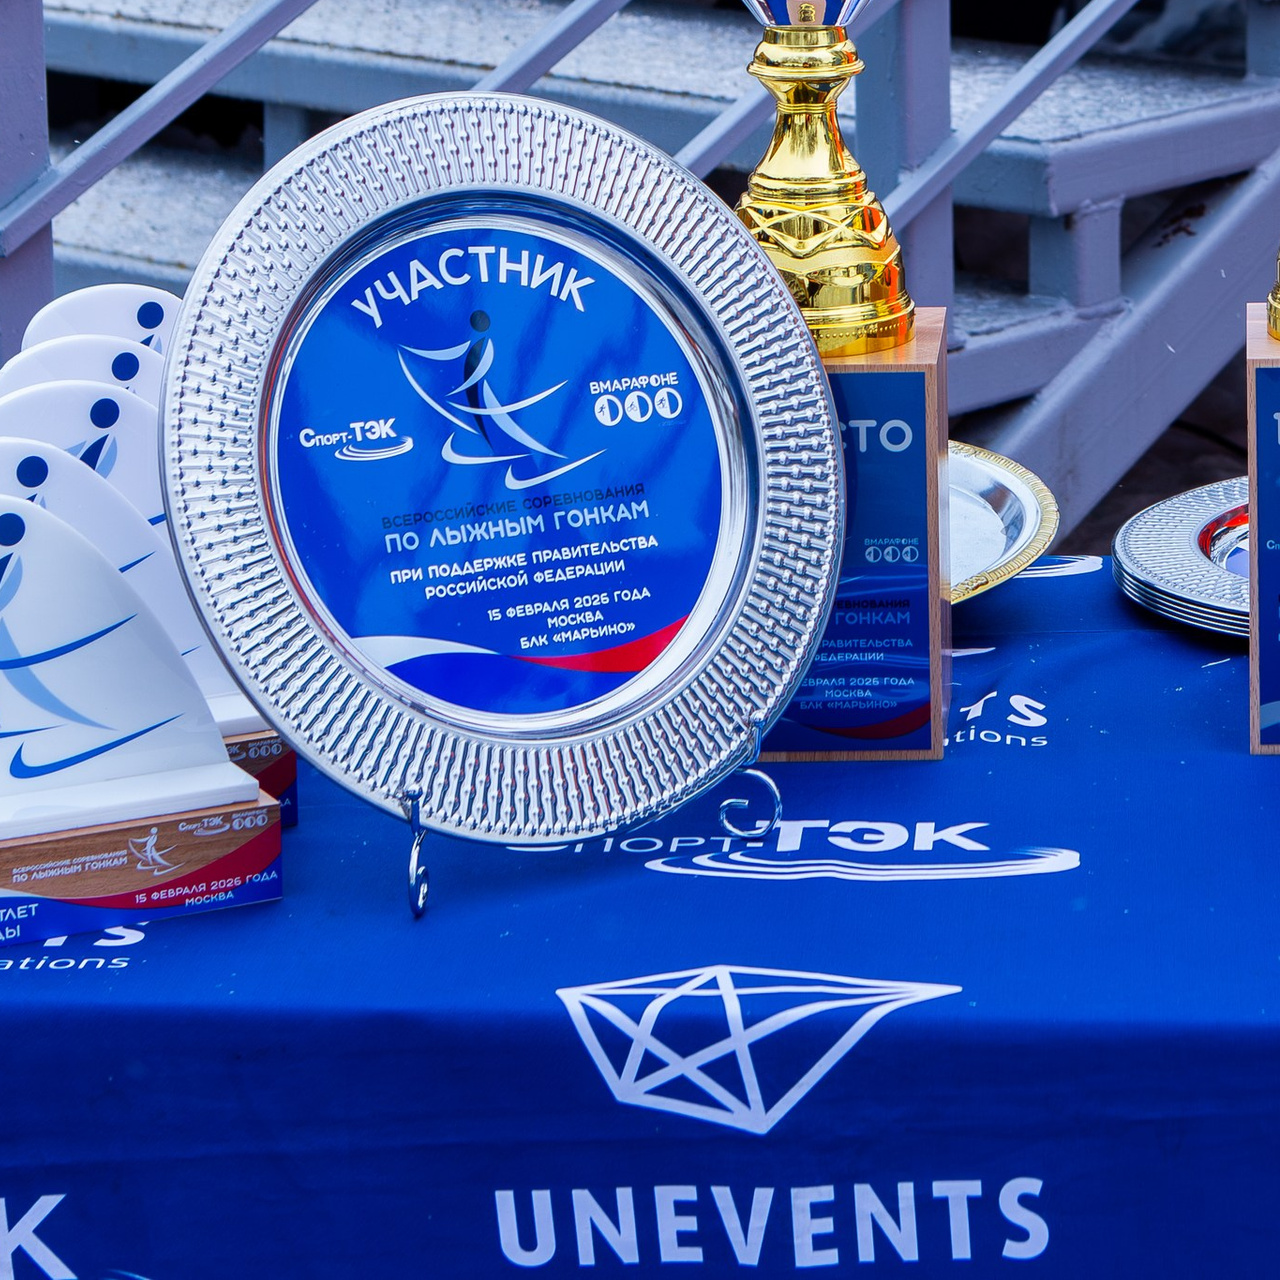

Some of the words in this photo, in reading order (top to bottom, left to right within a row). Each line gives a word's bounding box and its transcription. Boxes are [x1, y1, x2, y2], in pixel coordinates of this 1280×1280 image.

[351, 245, 595, 328] УЧАСТНИК
[589, 371, 679, 395] ВМАРАФОНЕ
[382, 499, 517, 530] ВСЕРОССИЙСКИЕ
[523, 483, 646, 511] СОРЕВНОВАНИЯ
[384, 533, 420, 554] ПО
[429, 515, 546, 548] ЛЫЖНЫМ
[553, 500, 650, 531] ГОНКАМ
[389, 568, 424, 584] ПРИ
[428, 552, 528, 579] ПОДДЕРЖКЕ
[532, 535, 659, 565] ПРАВИТЕЛЬСТВА
[424, 571, 529, 600] РОССИЙСКОЙ
[533, 559, 626, 586] ФЕДЕРАЦИИ
[487, 609, 502, 622] 15
[505, 598, 570, 619] ФЕВРАЛЯ
[573, 593, 610, 609] 2026
[613, 587, 651, 603] ГОДА
[835, 611, 911, 625] ГОНКАМ
[546, 610, 604, 629] МОСКВА
[519, 634, 549, 650] БЛК
[552, 621, 636, 644] «МАРЬИНО»
[820, 638, 913, 649] РАВИТЕЛЬСТВА
[801, 677, 846, 687] ЕВРАЛЯ
[883, 677, 915, 687] ГОДА
[825, 689, 873, 698] МОСКВА
[12, 873, 28, 883] ПО
[31, 864, 82, 881] ЛЫЖНЫМ
[85, 856, 128, 871] ГОНКАМ
[135, 893, 147, 904] 15
[149, 881, 207, 902] ФЕВРАЛЯ
[210, 876, 242, 891] 2026
[245, 870, 279, 885] ГОДА
[185, 891, 235, 908] МОСКВА
[494, 1176, 1050, 1268] UNEVENTS
